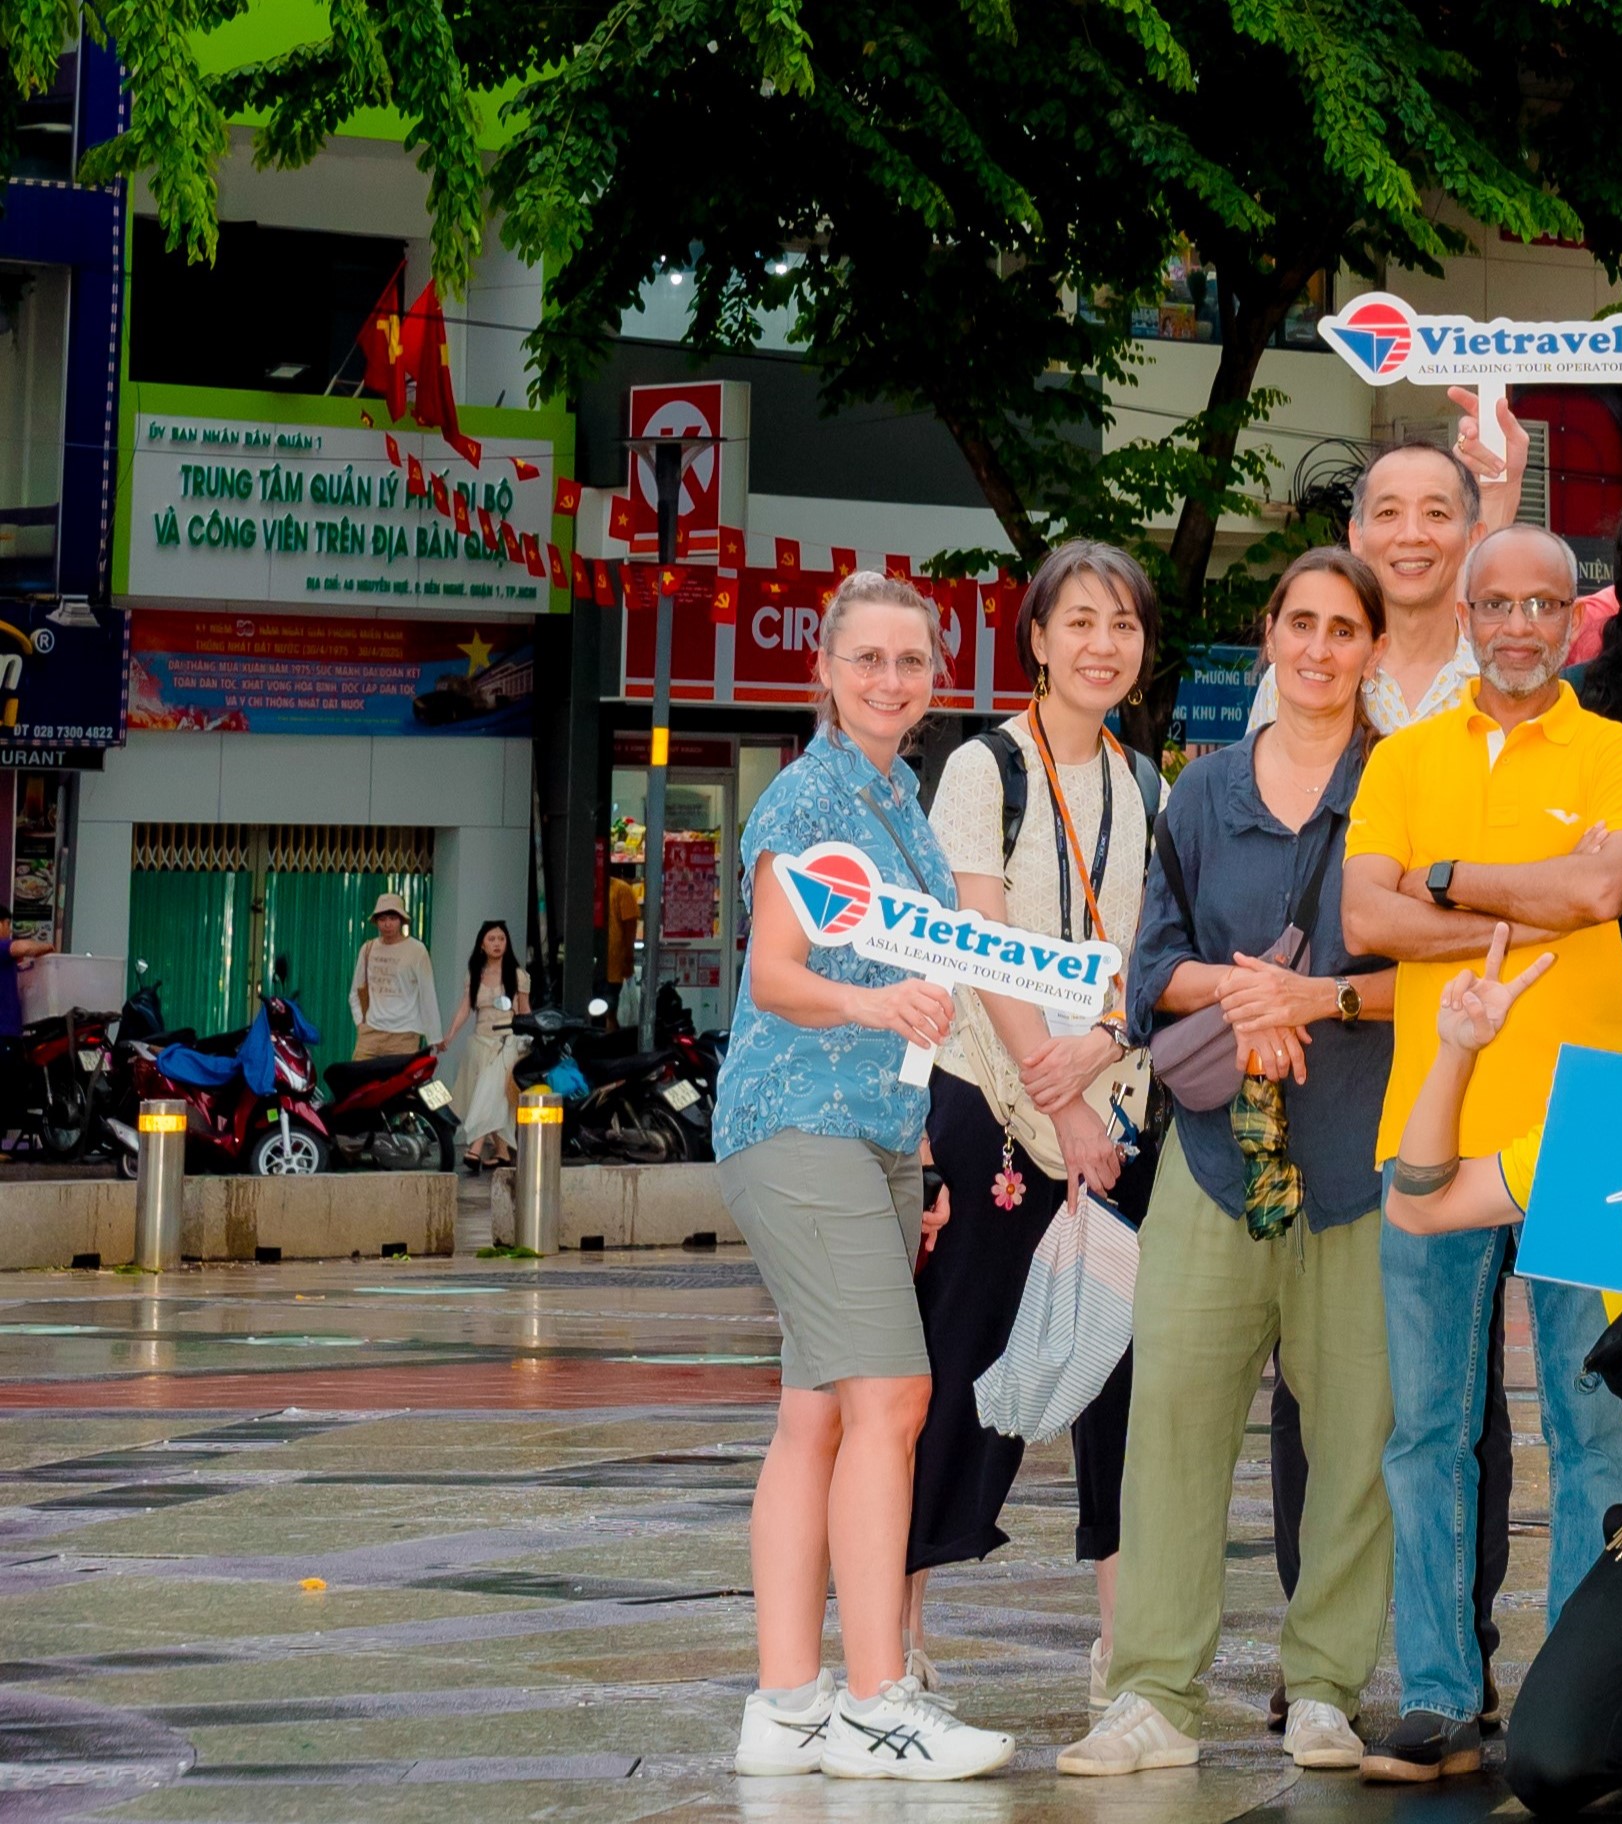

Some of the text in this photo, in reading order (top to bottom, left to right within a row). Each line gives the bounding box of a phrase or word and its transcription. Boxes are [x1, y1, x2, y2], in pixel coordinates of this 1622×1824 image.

[1418, 365, 1449, 374] ASIA
[1453, 364, 1512, 374] LEADING
[1517, 363, 1552, 373] TOUR
[171, 427, 198, 442] BAN
[181, 464, 253, 499] TRUNG
[259, 463, 303, 502] TÂM
[311, 463, 372, 506] QUẢN
[379, 469, 399, 508] LÝ
[484, 477, 513, 520] BỘ
[155, 505, 181, 545] VÀ
[188, 508, 257, 548] CÔNG
[263, 513, 308, 552] VIÊN
[315, 515, 366, 555] TRÊN
[373, 524, 408, 563] ĐỊA
[417, 520, 459, 560] BÀN
[751, 606, 818, 651] CIR
[1194, 665, 1240, 686] PHƯỜNG
[1192, 707, 1216, 721] KHU
[1220, 701, 1243, 722] PHỐ
[33, 725, 54, 738] 028
[57, 726, 83, 739] 7300
[85, 727, 113, 739] 4822
[0, 750, 66, 766] URANT
[878, 895, 1102, 986] Vietravel
[865, 936, 1093, 1006] ASIA LEADING TOUR OPERATOR
